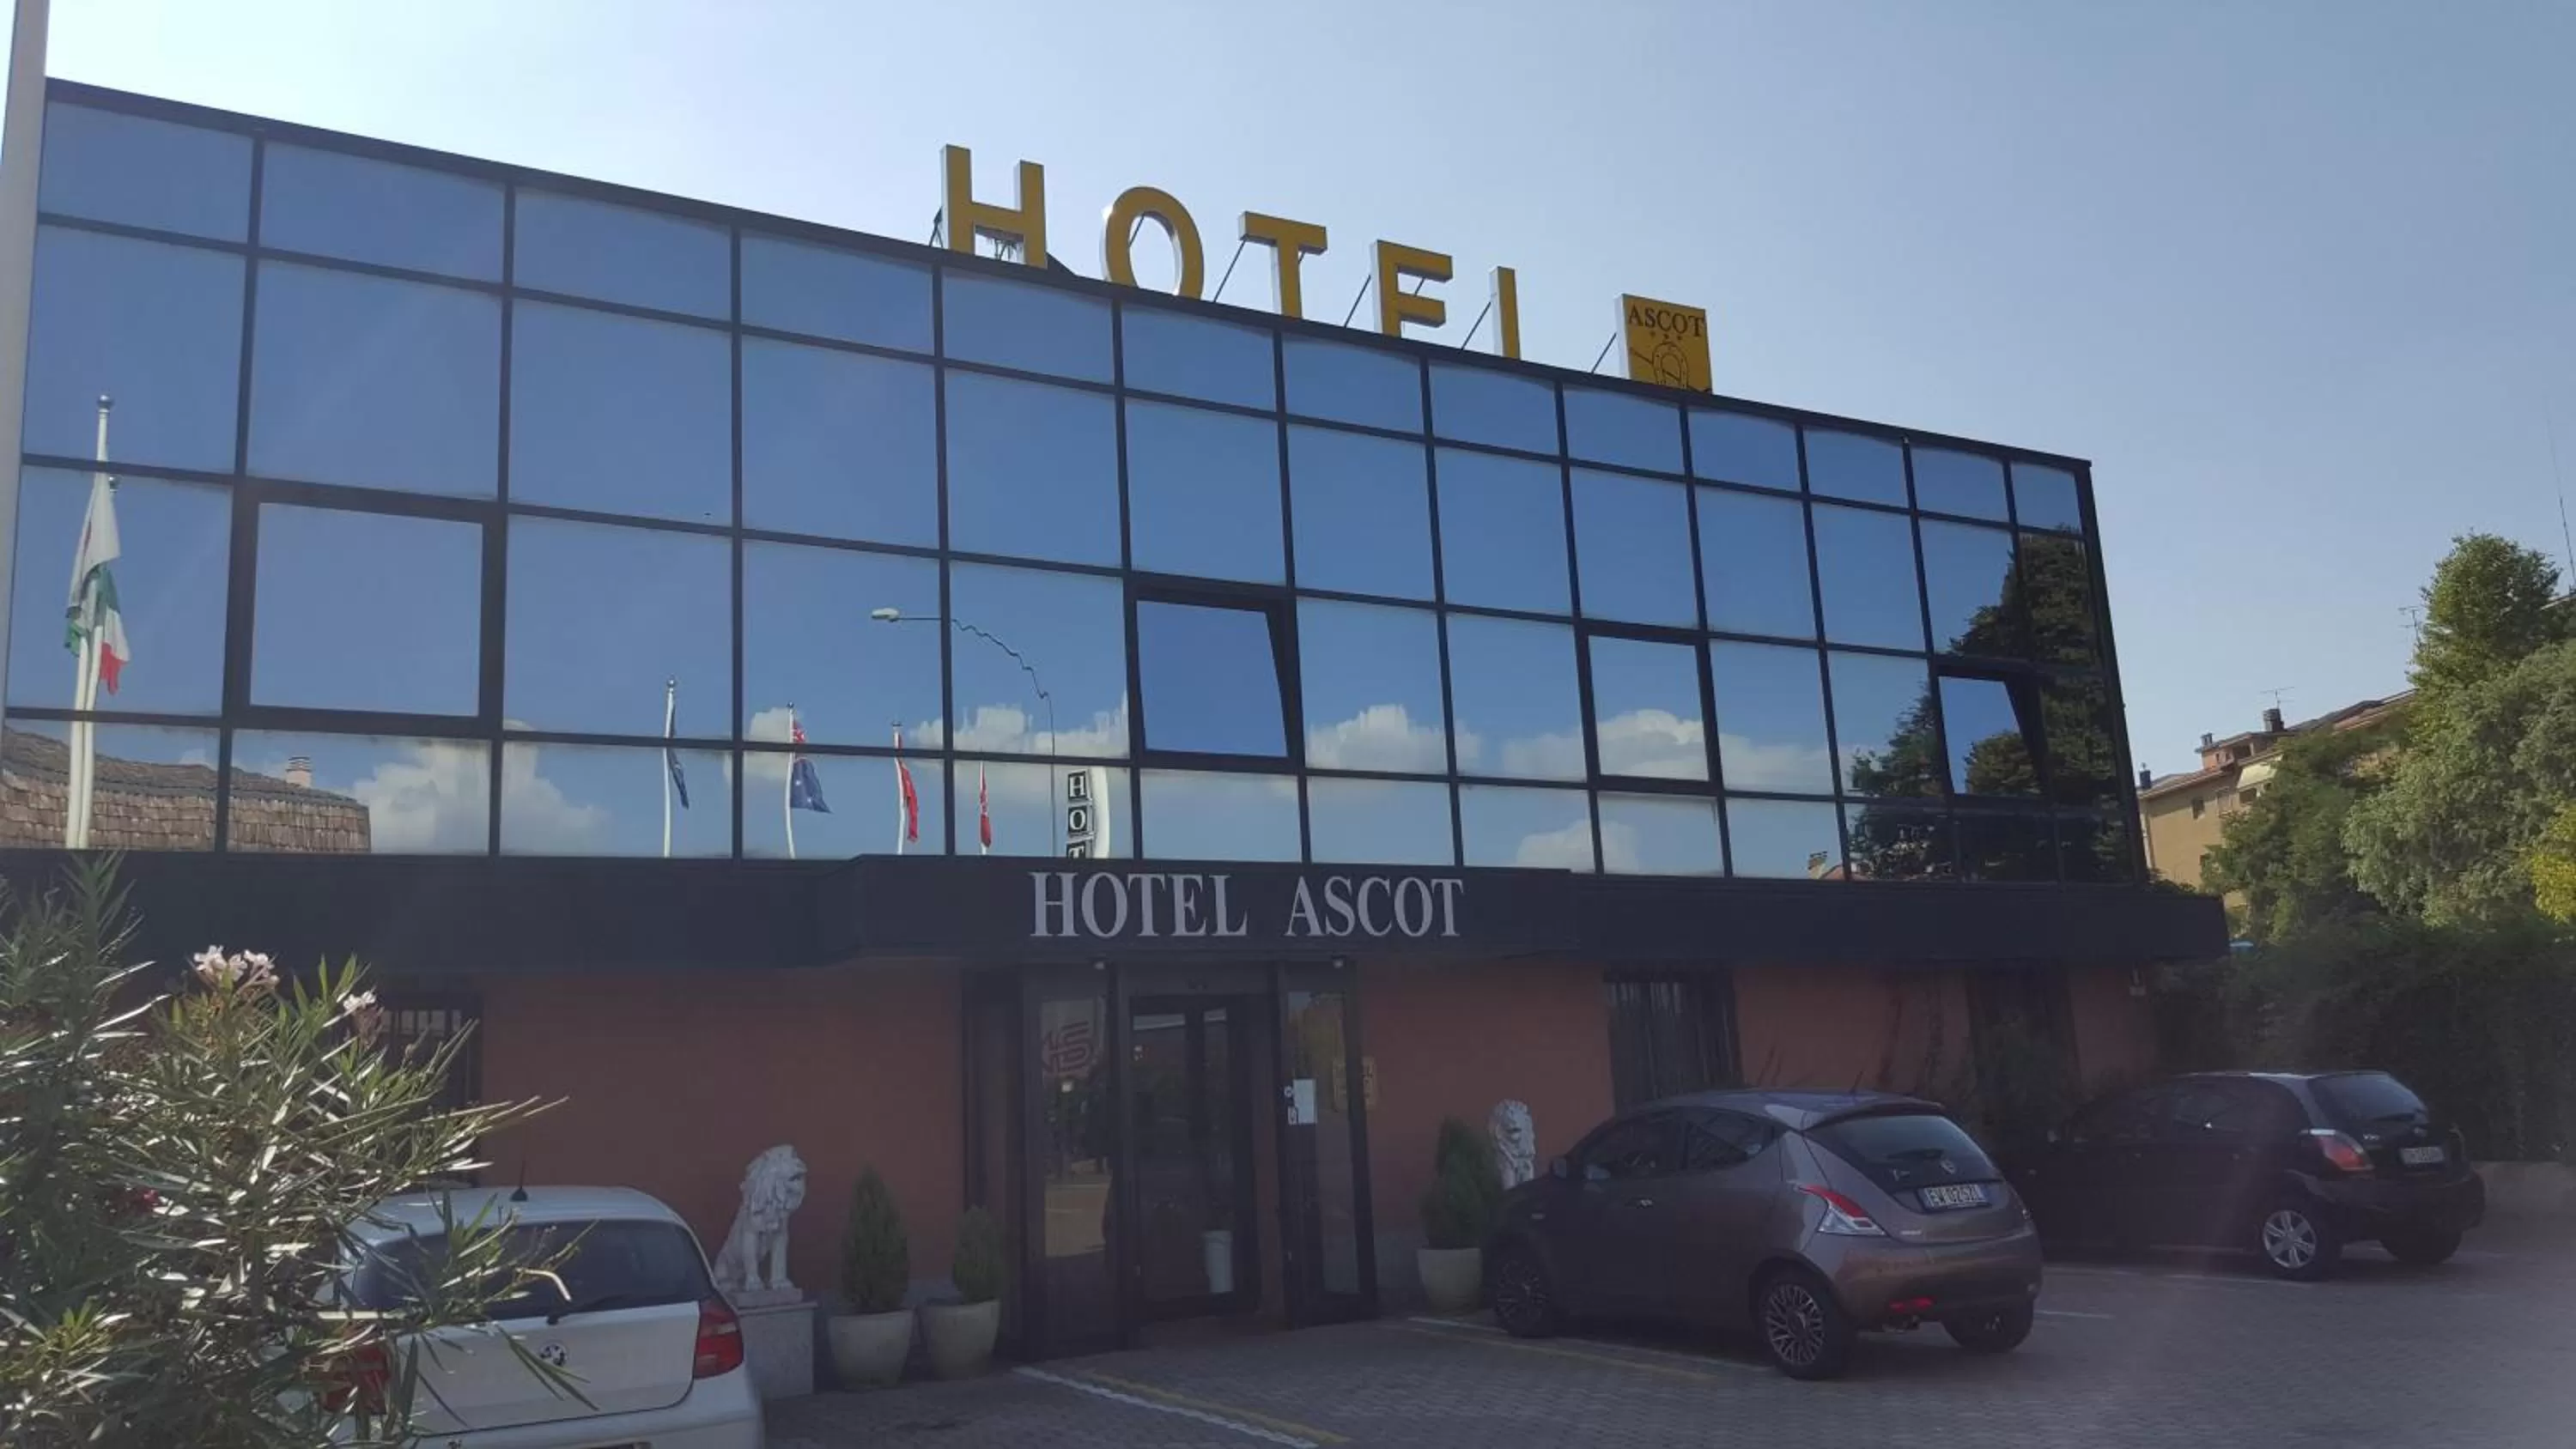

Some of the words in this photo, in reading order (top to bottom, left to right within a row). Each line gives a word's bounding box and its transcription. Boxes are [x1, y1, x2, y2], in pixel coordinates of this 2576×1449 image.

[1628, 304, 1704, 337] ASCOT
[1029, 871, 1249, 938] HOTEL
[1284, 876, 1464, 938] ASCOT
